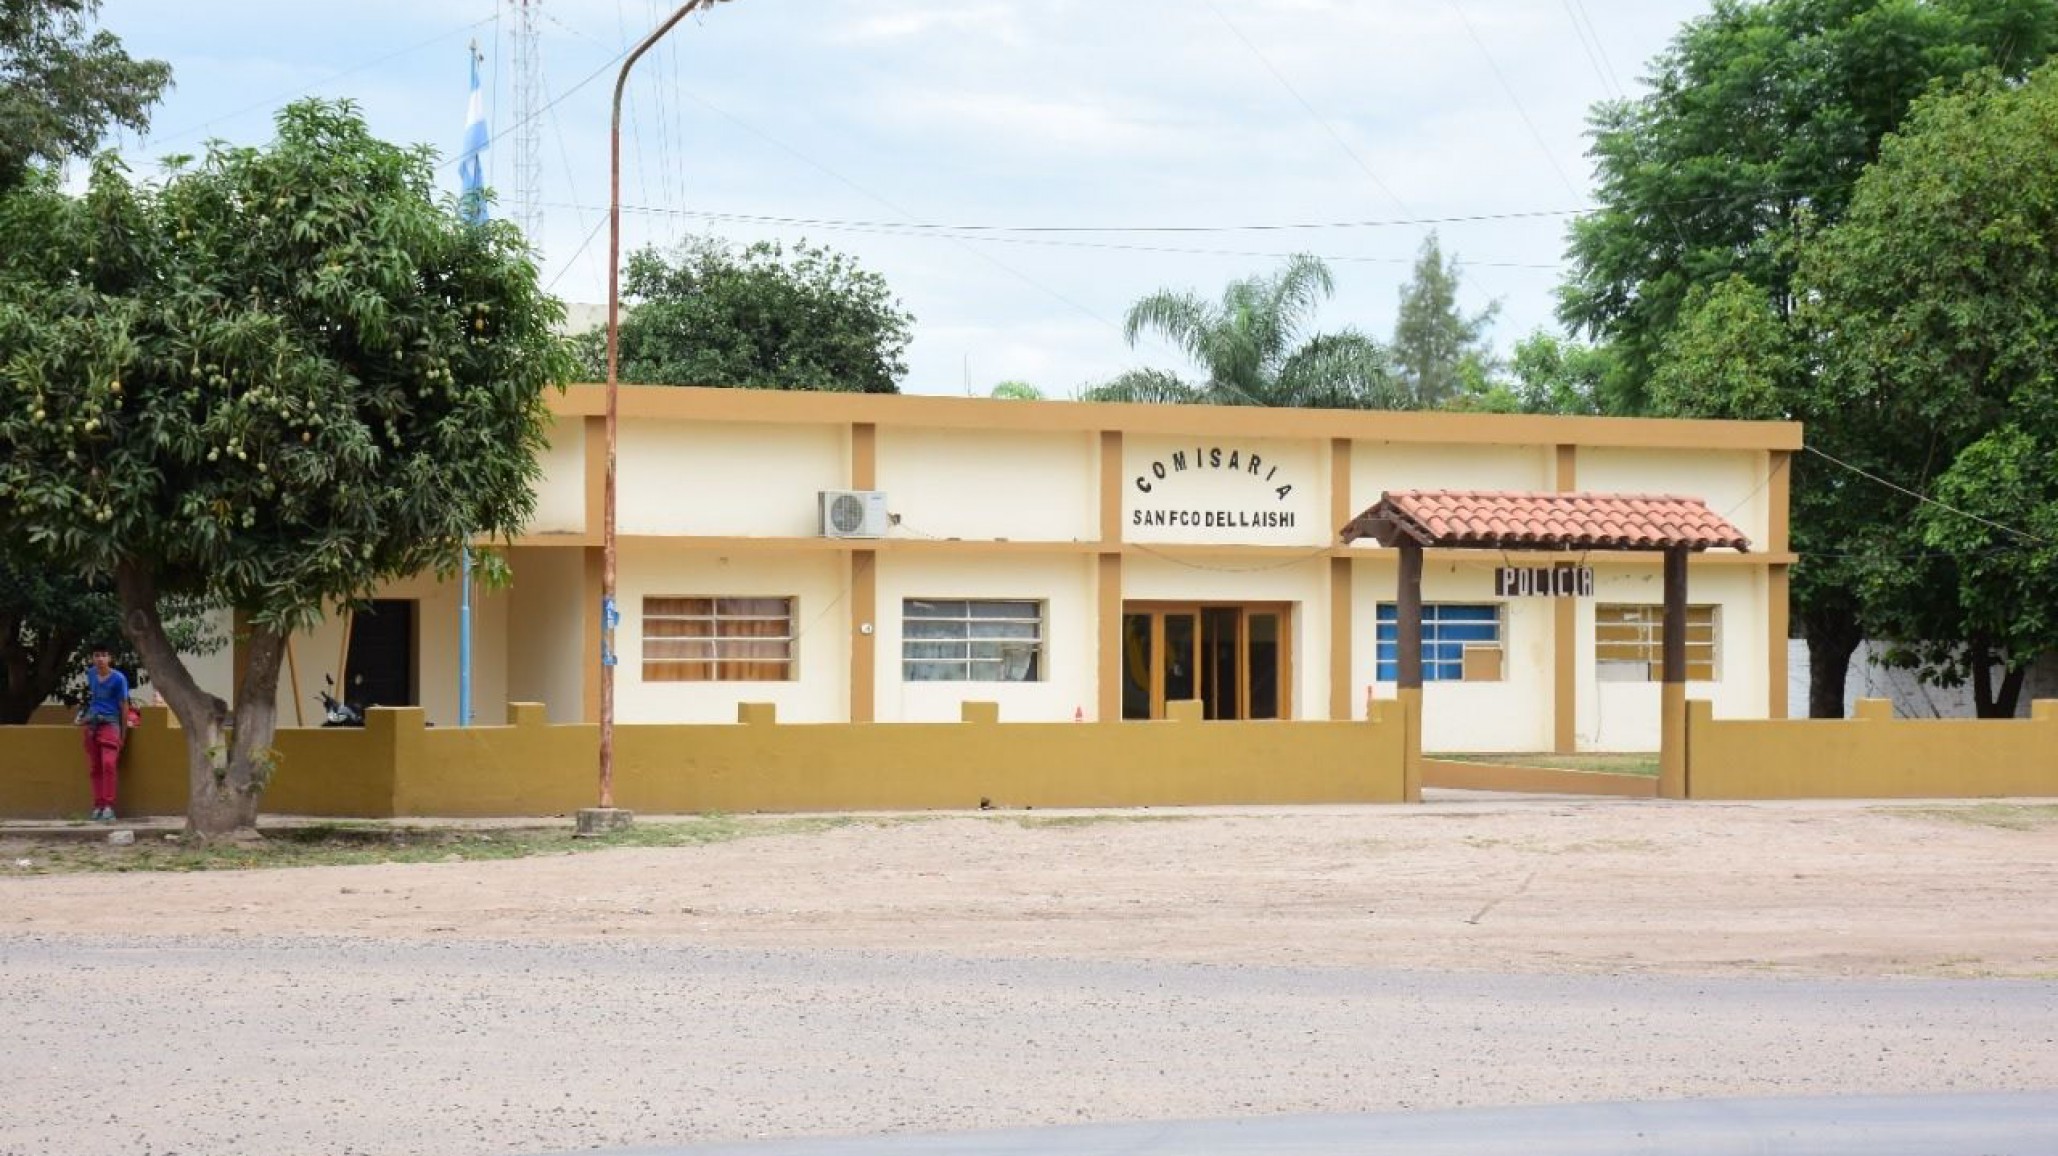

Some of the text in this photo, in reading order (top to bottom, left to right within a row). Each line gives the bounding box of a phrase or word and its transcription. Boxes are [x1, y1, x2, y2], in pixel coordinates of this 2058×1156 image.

[1136, 447, 1293, 500] COMISARIA
[1133, 509, 1165, 526] SAN
[1169, 511, 1200, 526] FCO
[1502, 567, 1593, 597] POLICIA
